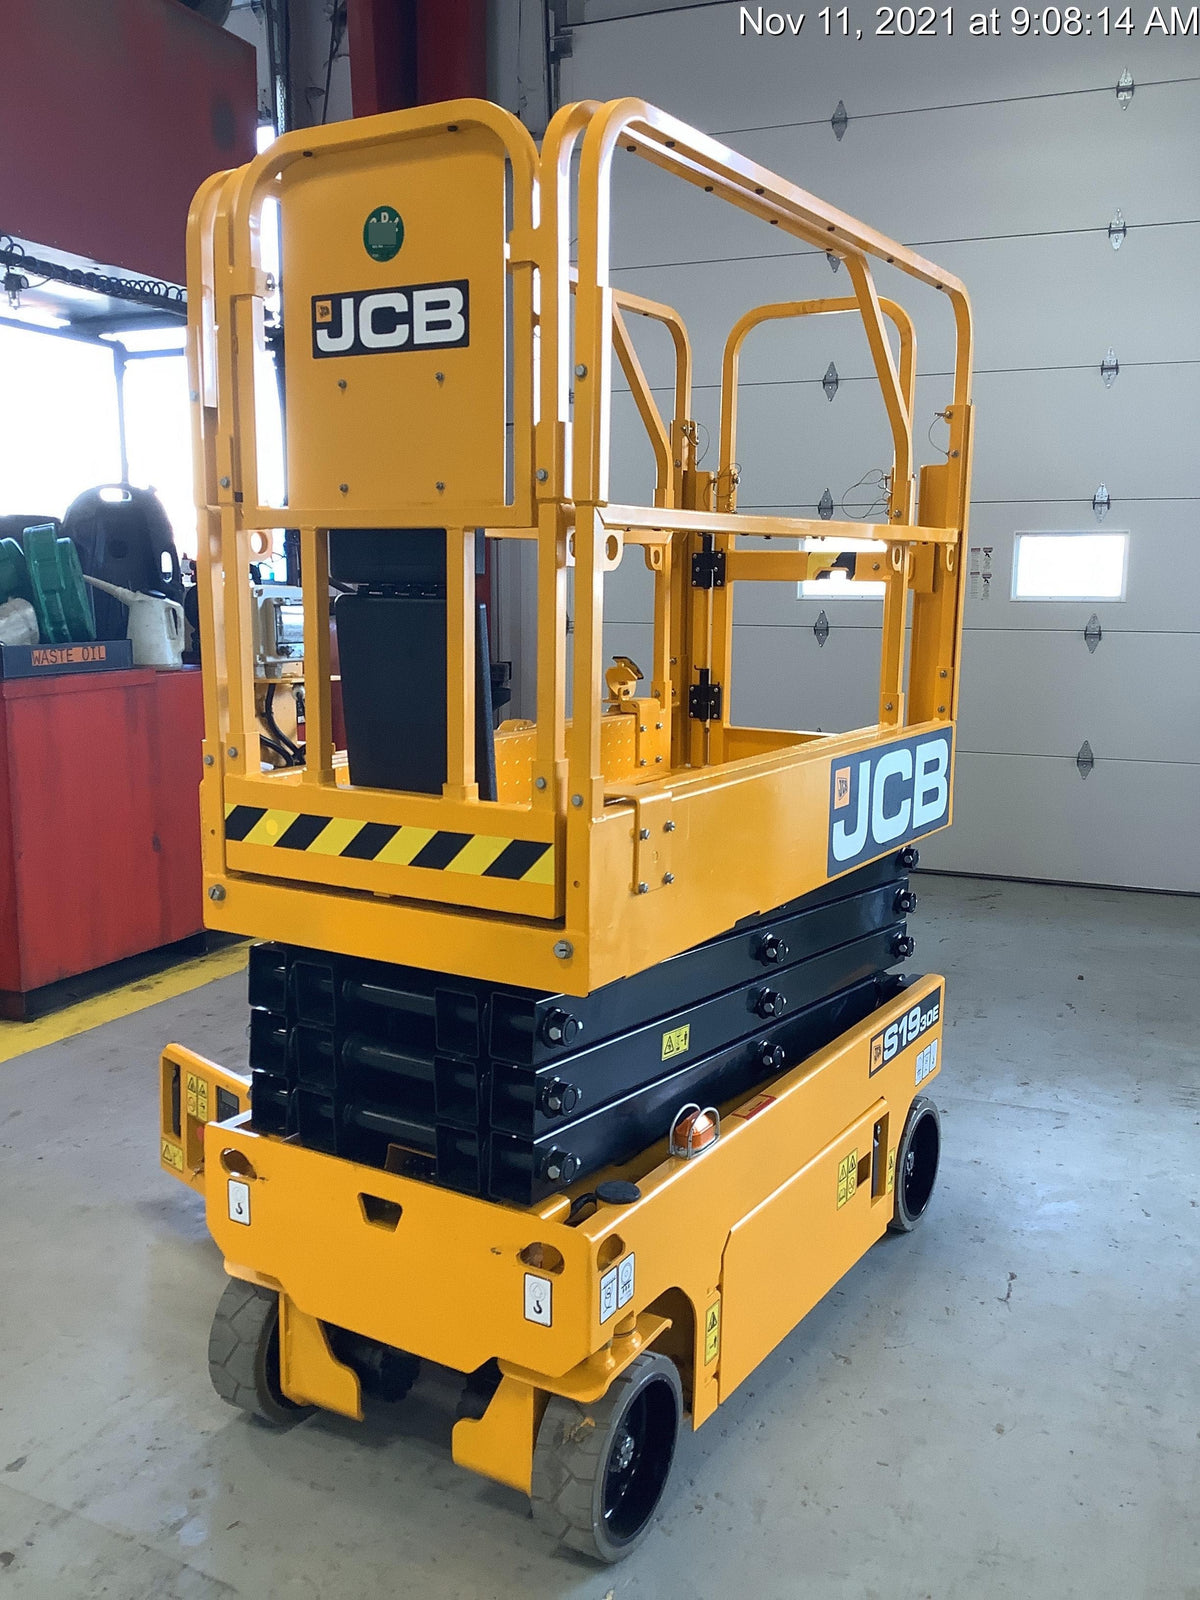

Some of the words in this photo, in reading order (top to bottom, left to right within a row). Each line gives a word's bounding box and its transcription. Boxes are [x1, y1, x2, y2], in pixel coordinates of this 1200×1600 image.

[316, 287, 465, 352] JCB
[32, 648, 74, 665] WASTE
[81, 646, 106, 661] OIL
[832, 739, 949, 862] JCB
[883, 1004, 939, 1060] S1930E
